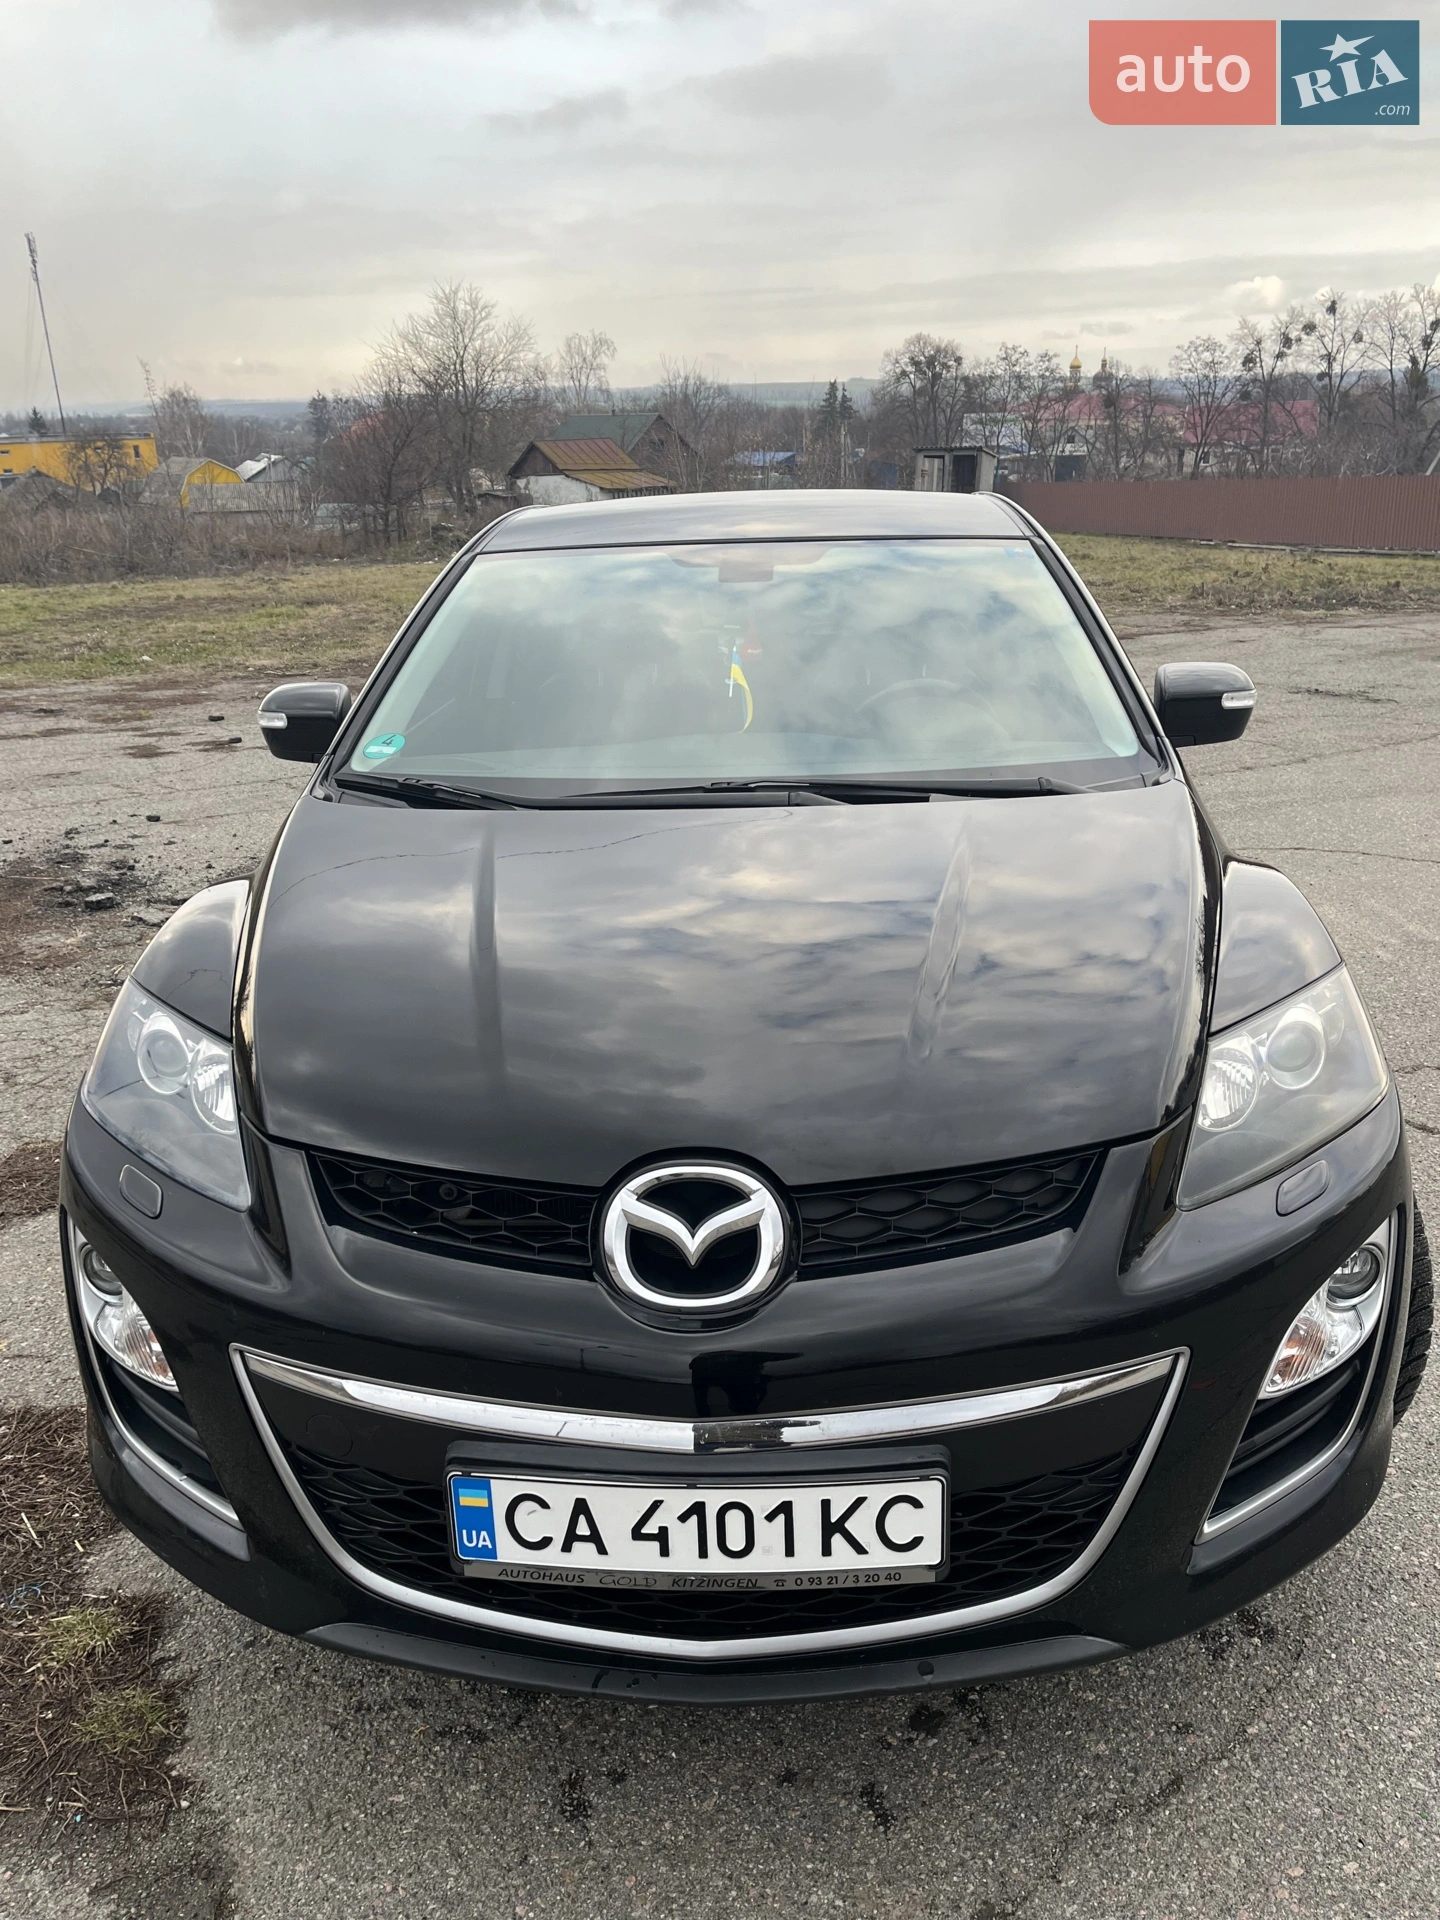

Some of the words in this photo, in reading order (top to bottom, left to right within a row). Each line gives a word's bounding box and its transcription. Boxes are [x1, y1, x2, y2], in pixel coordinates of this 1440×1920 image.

[382, 734, 396, 746] 4
[504, 1493, 609, 1556] CA
[631, 1499, 795, 1559] 4101
[820, 1494, 925, 1558] KC
[462, 1529, 493, 1549] UA
[498, 1568, 586, 1584] AUTOHAUS
[599, 1574, 658, 1588] GOLD
[671, 1577, 758, 1589] KITZINGEN
[794, 1577, 804, 1587] 0
[809, 1576, 823, 1586] 93
[826, 1575, 839, 1585] 21
[852, 1574, 860, 1584] 3
[864, 1573, 880, 1583] 20
[885, 1572, 902, 1582] 40
